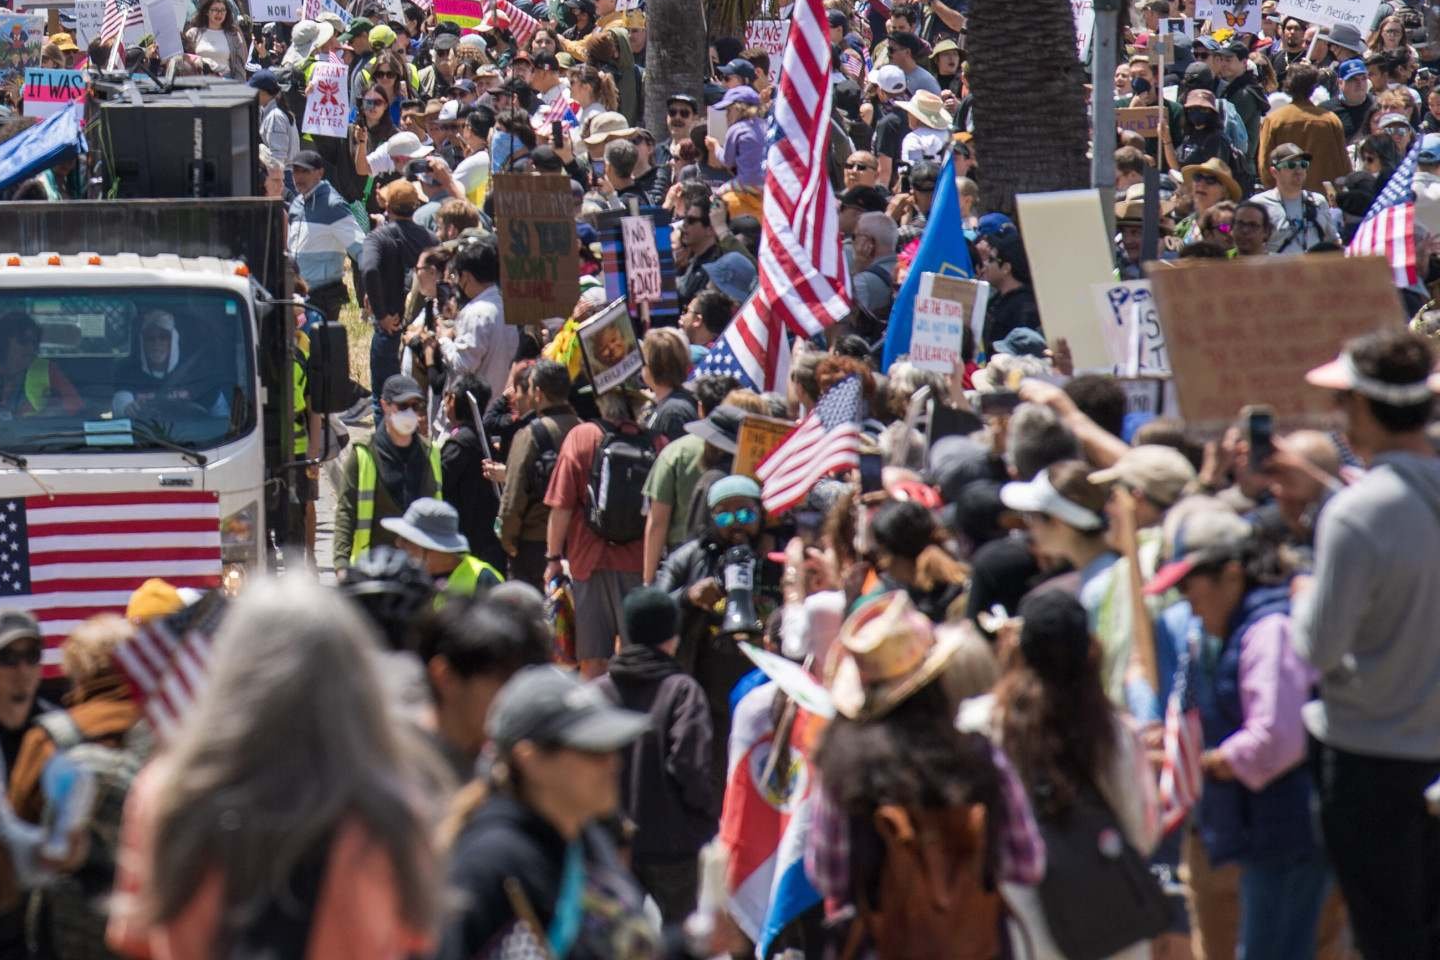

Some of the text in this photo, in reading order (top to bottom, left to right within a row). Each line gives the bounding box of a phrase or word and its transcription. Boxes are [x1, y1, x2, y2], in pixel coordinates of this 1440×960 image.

[28, 72, 84, 99] IT WAS
[312, 103, 346, 117] LIVES
[307, 115, 345, 129] MATTER
[631, 226, 647, 242] NO
